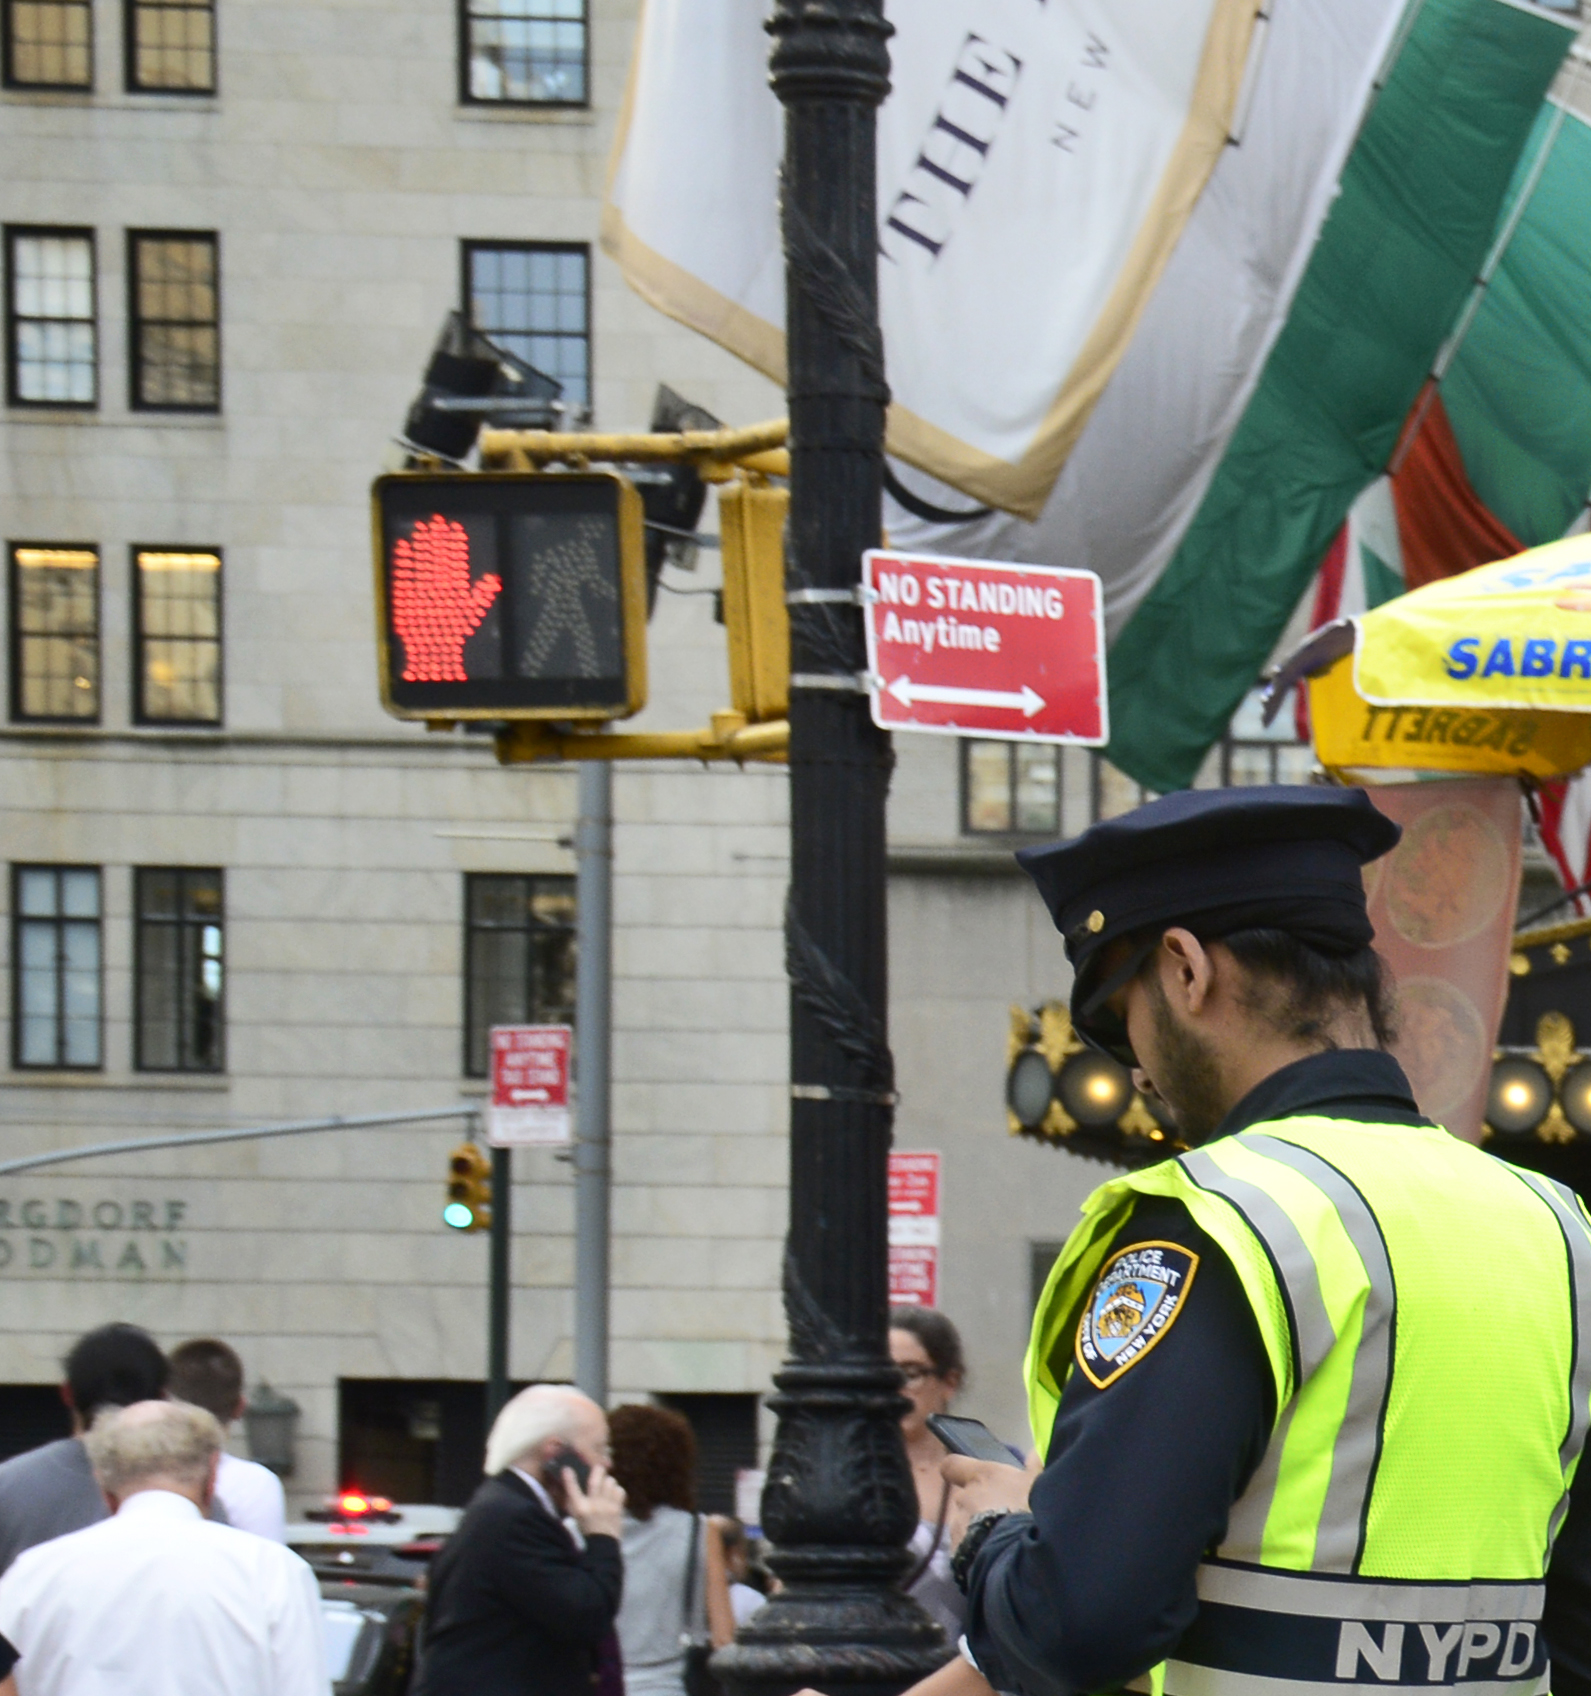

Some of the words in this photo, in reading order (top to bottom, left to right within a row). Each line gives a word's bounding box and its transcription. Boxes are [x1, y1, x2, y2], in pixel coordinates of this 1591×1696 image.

[1049, 32, 1110, 155] NEW
[872, 33, 1023, 263] THE
[878, 572, 921, 607] NO
[925, 576, 1065, 620] STANDING
[883, 611, 1002, 653] Anytime
[1112, 1248, 1164, 1272] POLICE
[1114, 1335, 1148, 1367] NEW
[1142, 1293, 1180, 1337] YORK
[1334, 1620, 1538, 1682] NYPD
